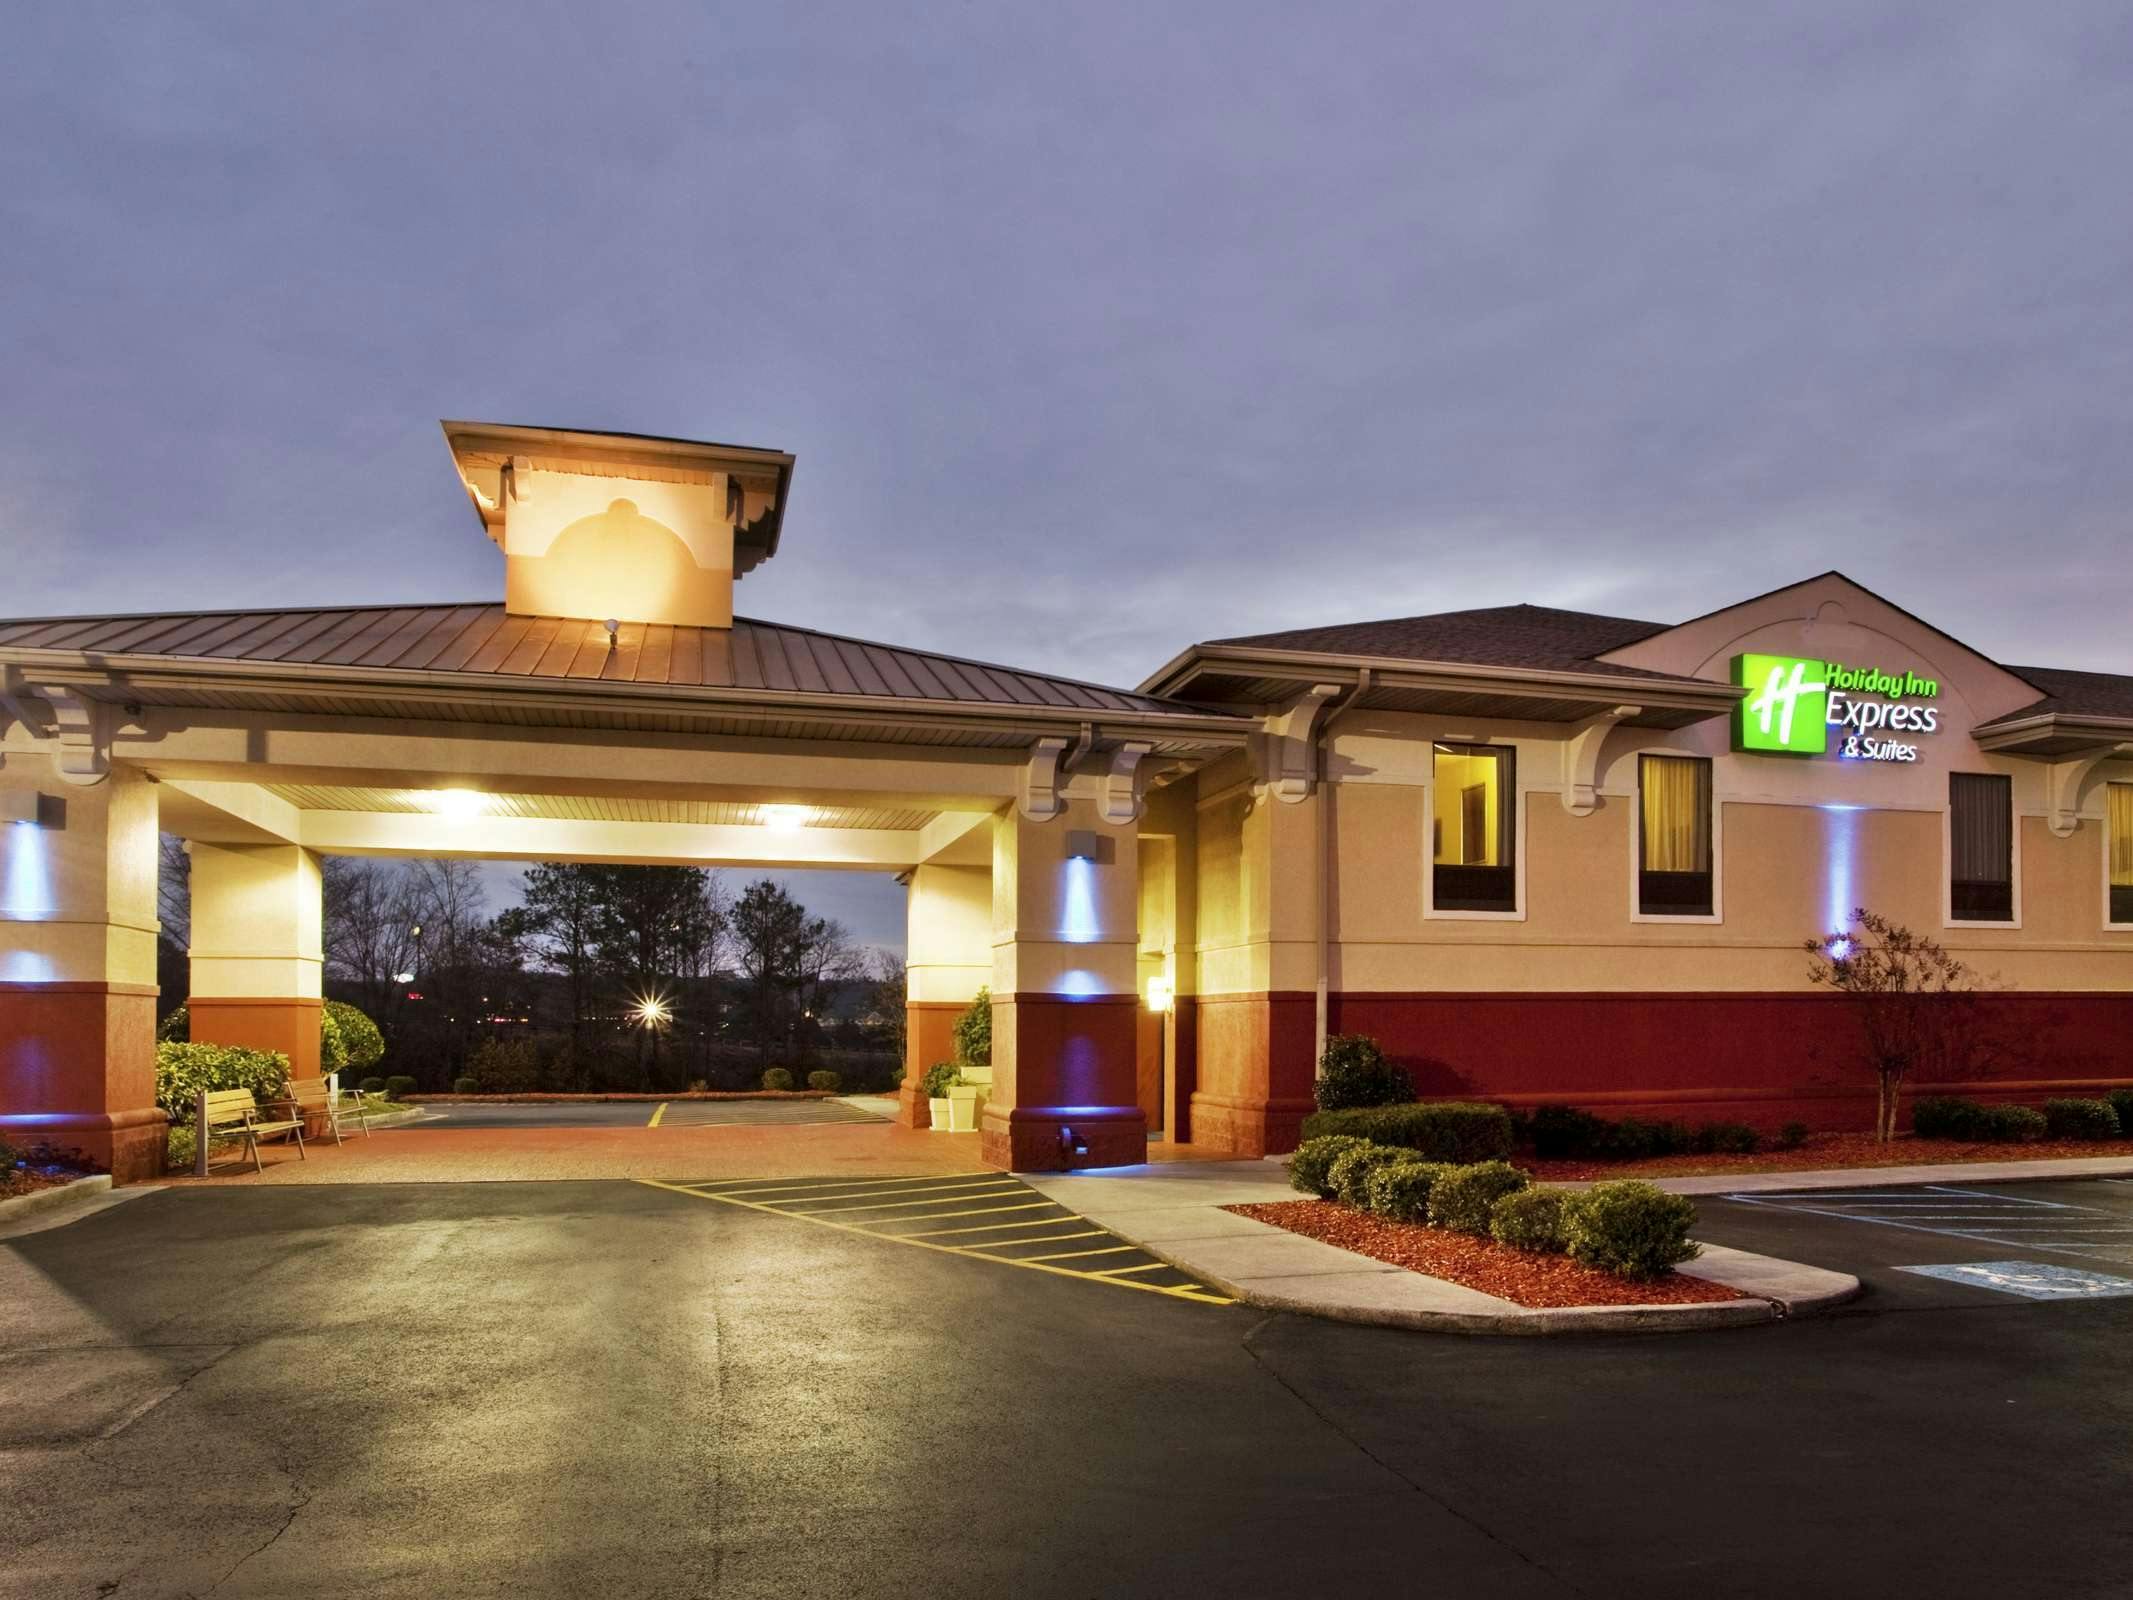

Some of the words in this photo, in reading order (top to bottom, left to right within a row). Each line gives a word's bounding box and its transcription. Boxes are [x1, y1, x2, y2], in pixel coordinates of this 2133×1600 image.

[1825, 664, 1903, 698] Holiday
[1906, 671, 1937, 697] Inn
[1826, 692, 1938, 735] Express
[1844, 736, 1859, 758] &
[1862, 738, 1917, 761] Suites
